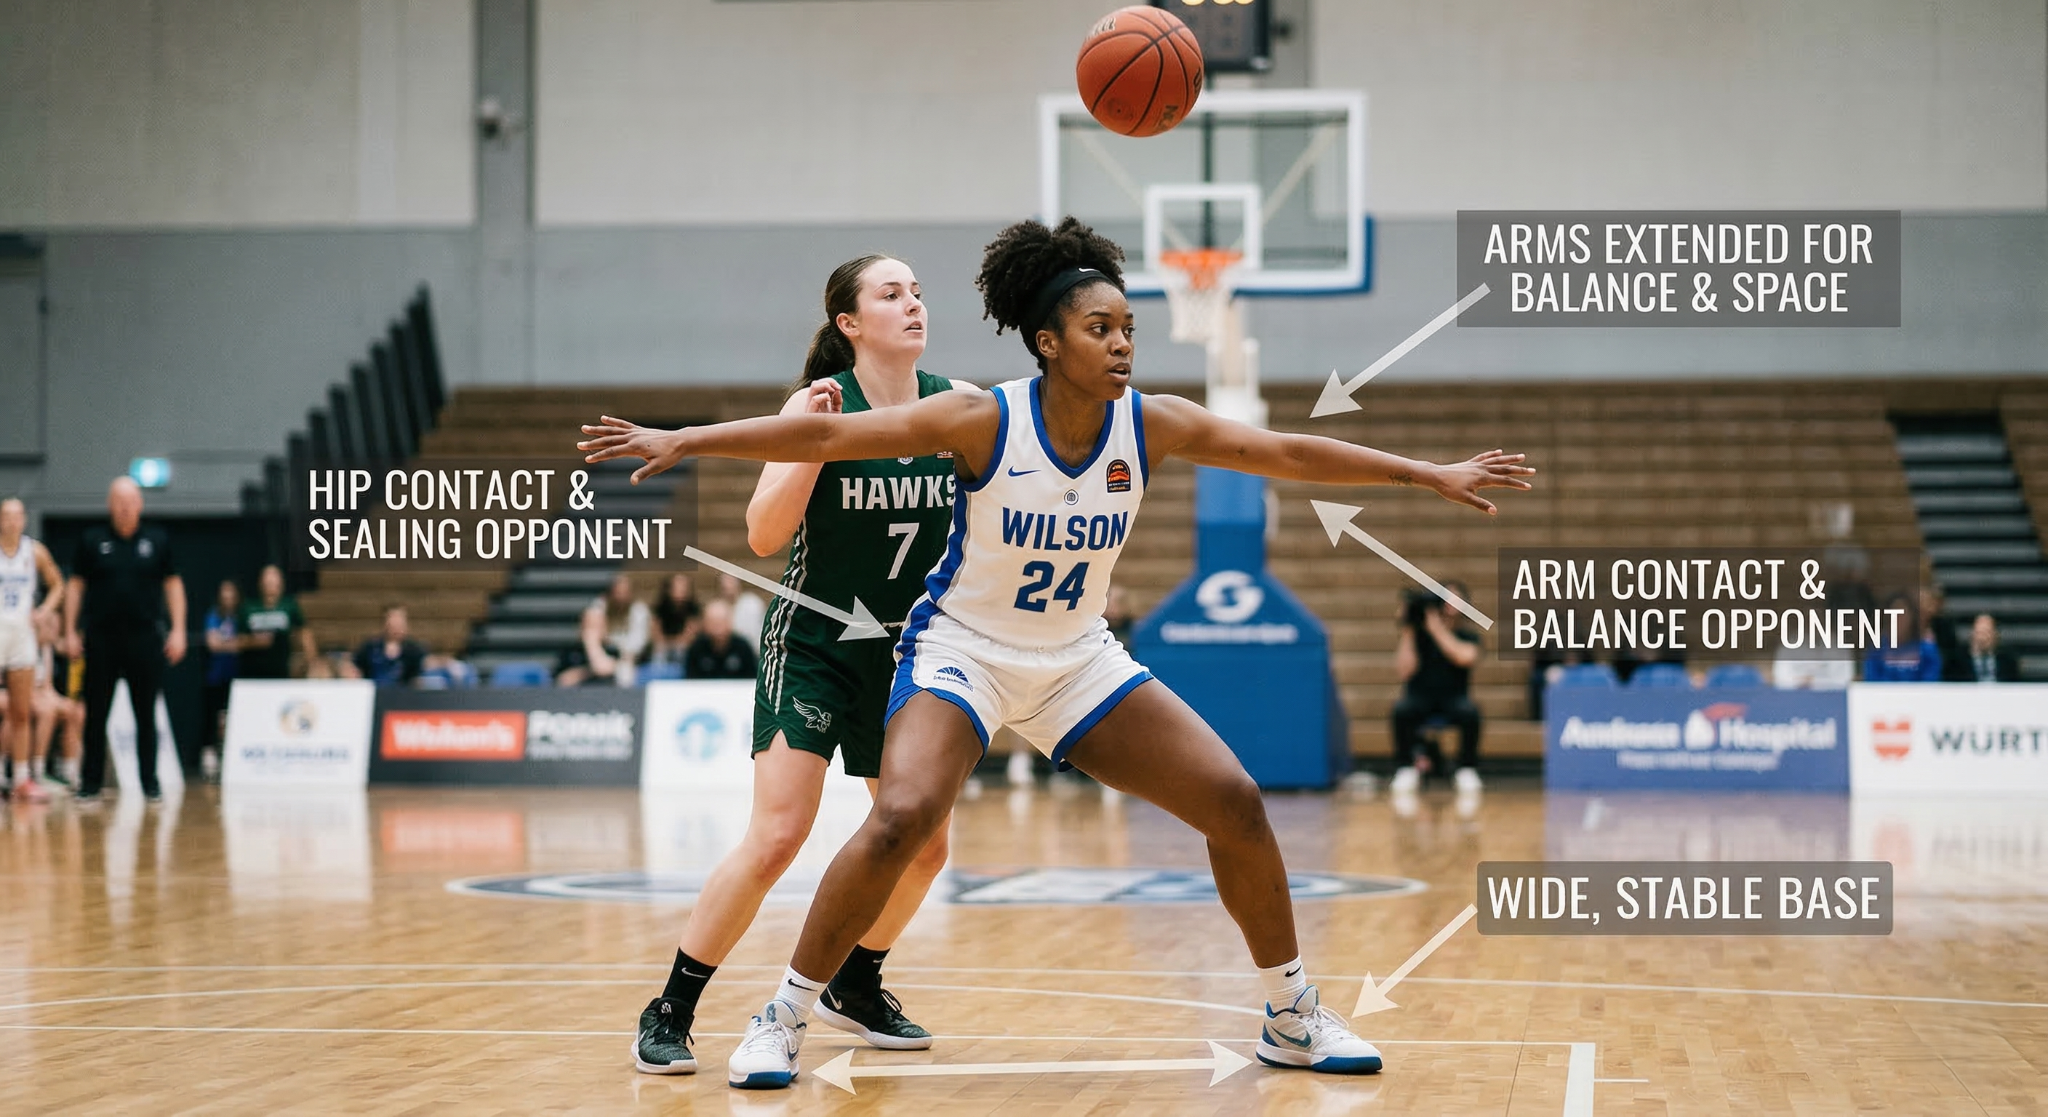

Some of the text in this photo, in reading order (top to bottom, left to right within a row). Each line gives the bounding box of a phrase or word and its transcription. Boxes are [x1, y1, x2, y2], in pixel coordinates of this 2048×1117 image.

[840, 474, 957, 510] HAWKS
[887, 522, 920, 580] 7
[1002, 507, 1128, 551] WILSON
[1013, 561, 1086, 613] 24
